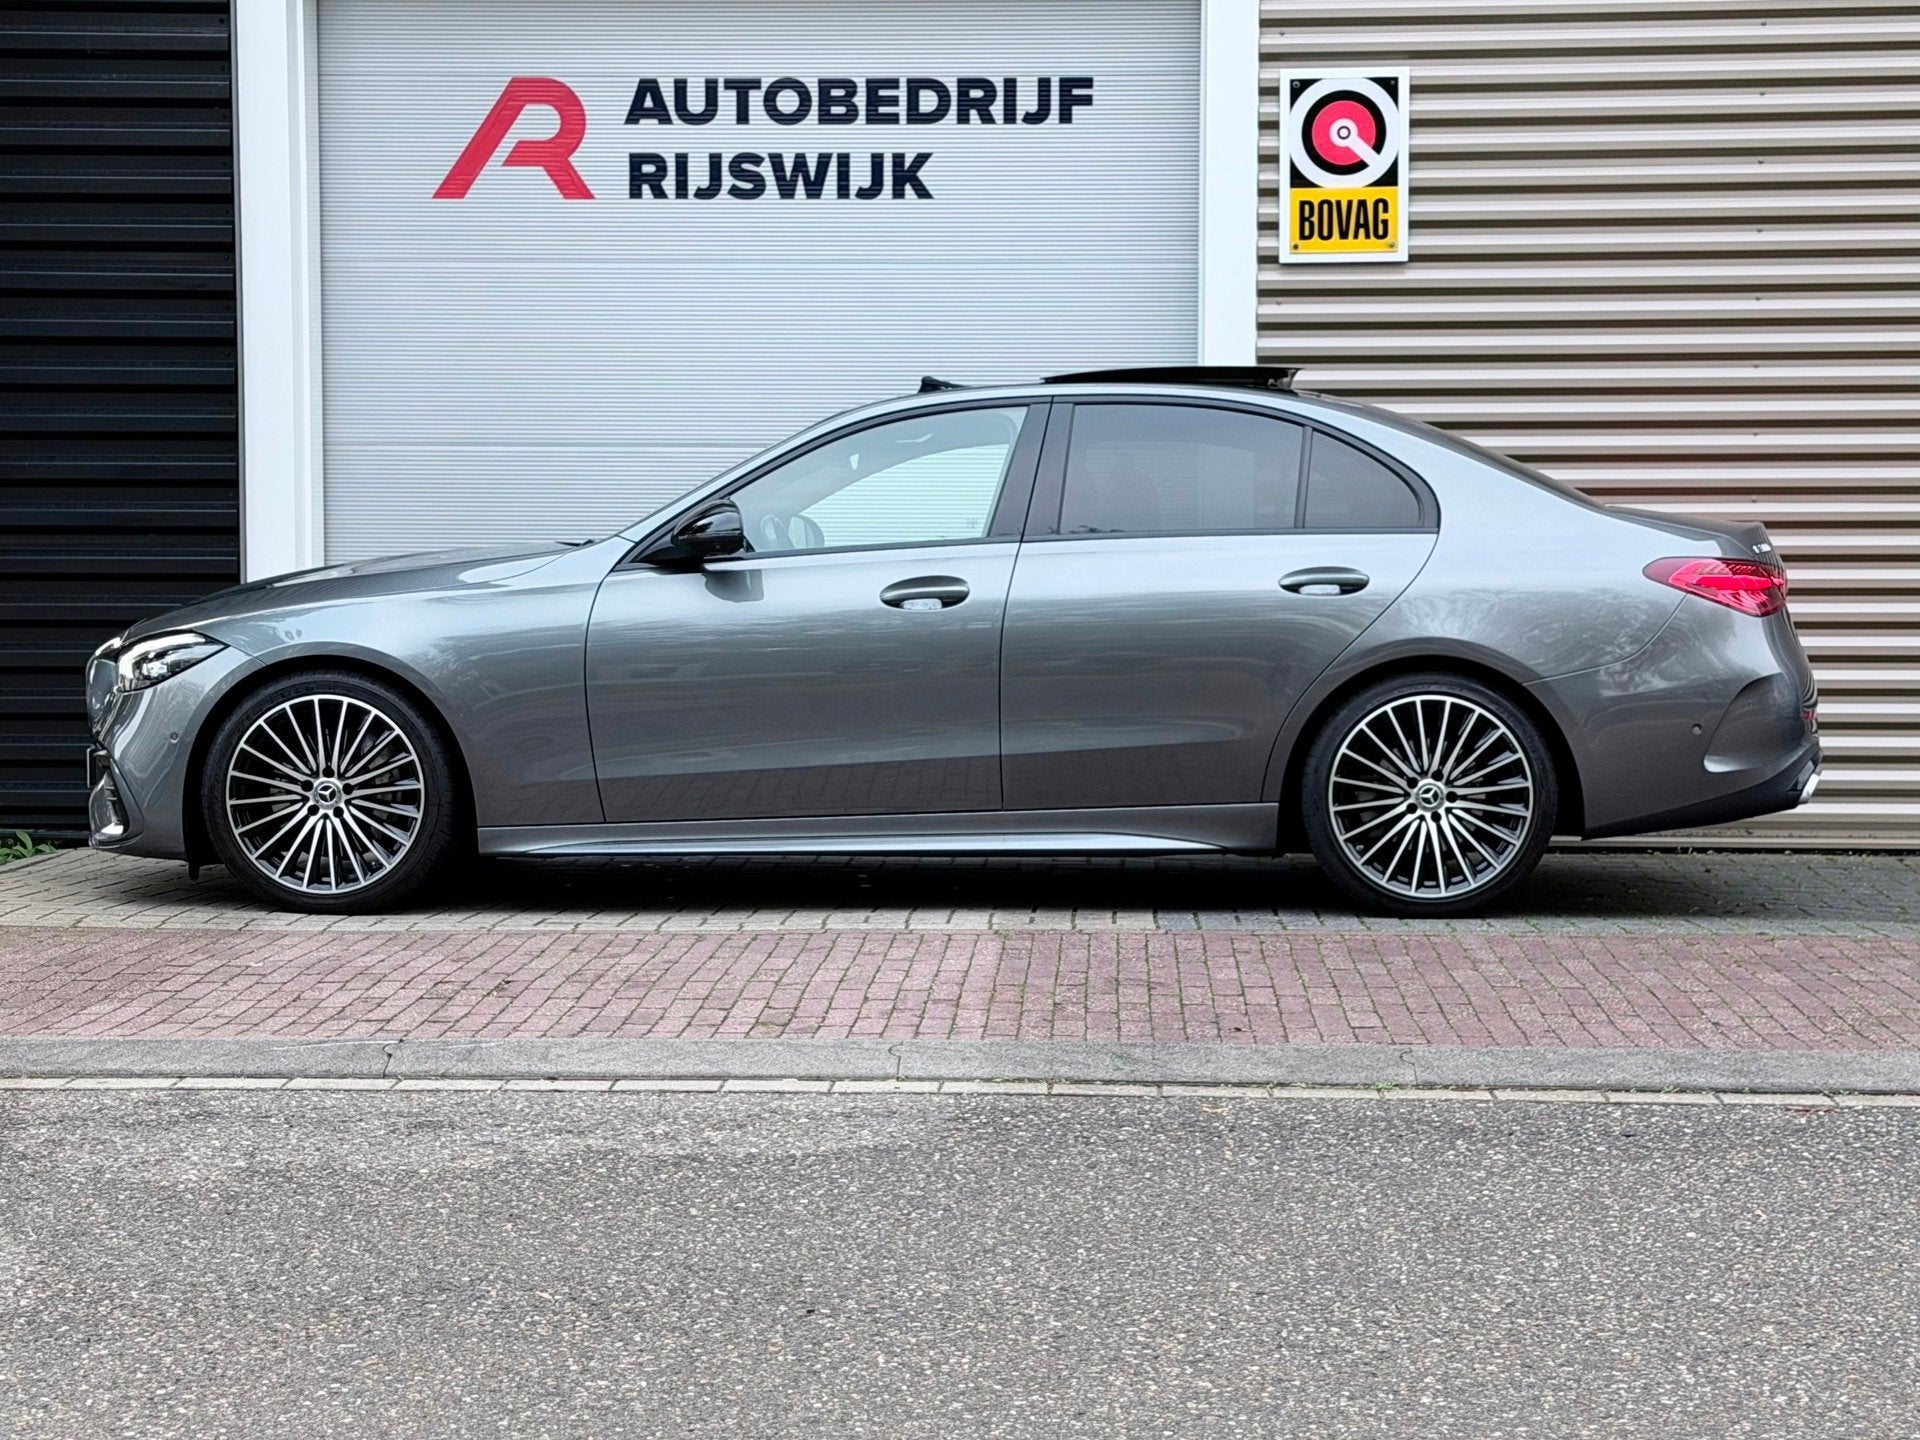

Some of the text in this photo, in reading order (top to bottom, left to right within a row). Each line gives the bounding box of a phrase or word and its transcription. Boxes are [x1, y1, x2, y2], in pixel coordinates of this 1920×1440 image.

[624, 77, 1094, 126] AUTOBEDRIJF
[628, 152, 934, 200] RIJSWIJK
[1299, 197, 1389, 241] BOVAG
